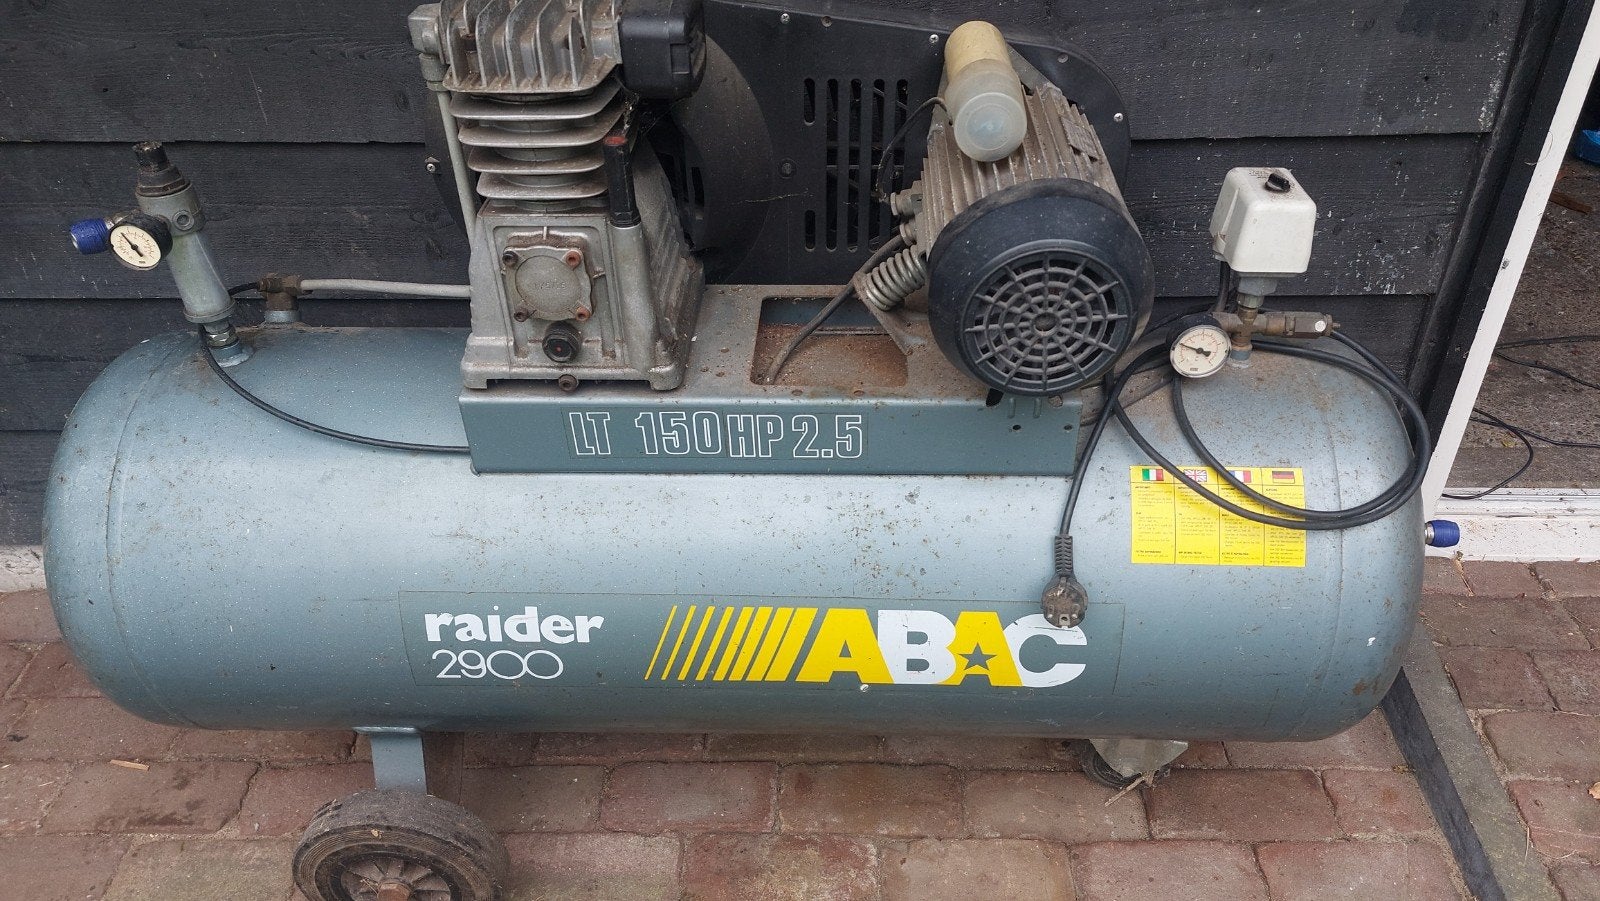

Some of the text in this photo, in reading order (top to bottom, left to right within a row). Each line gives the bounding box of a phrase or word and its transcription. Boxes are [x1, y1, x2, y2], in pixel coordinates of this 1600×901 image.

[569, 411, 612, 456] LT
[424, 605, 605, 644] raider
[431, 649, 564, 680] 2900
[795, 608, 1088, 688] ABAC
